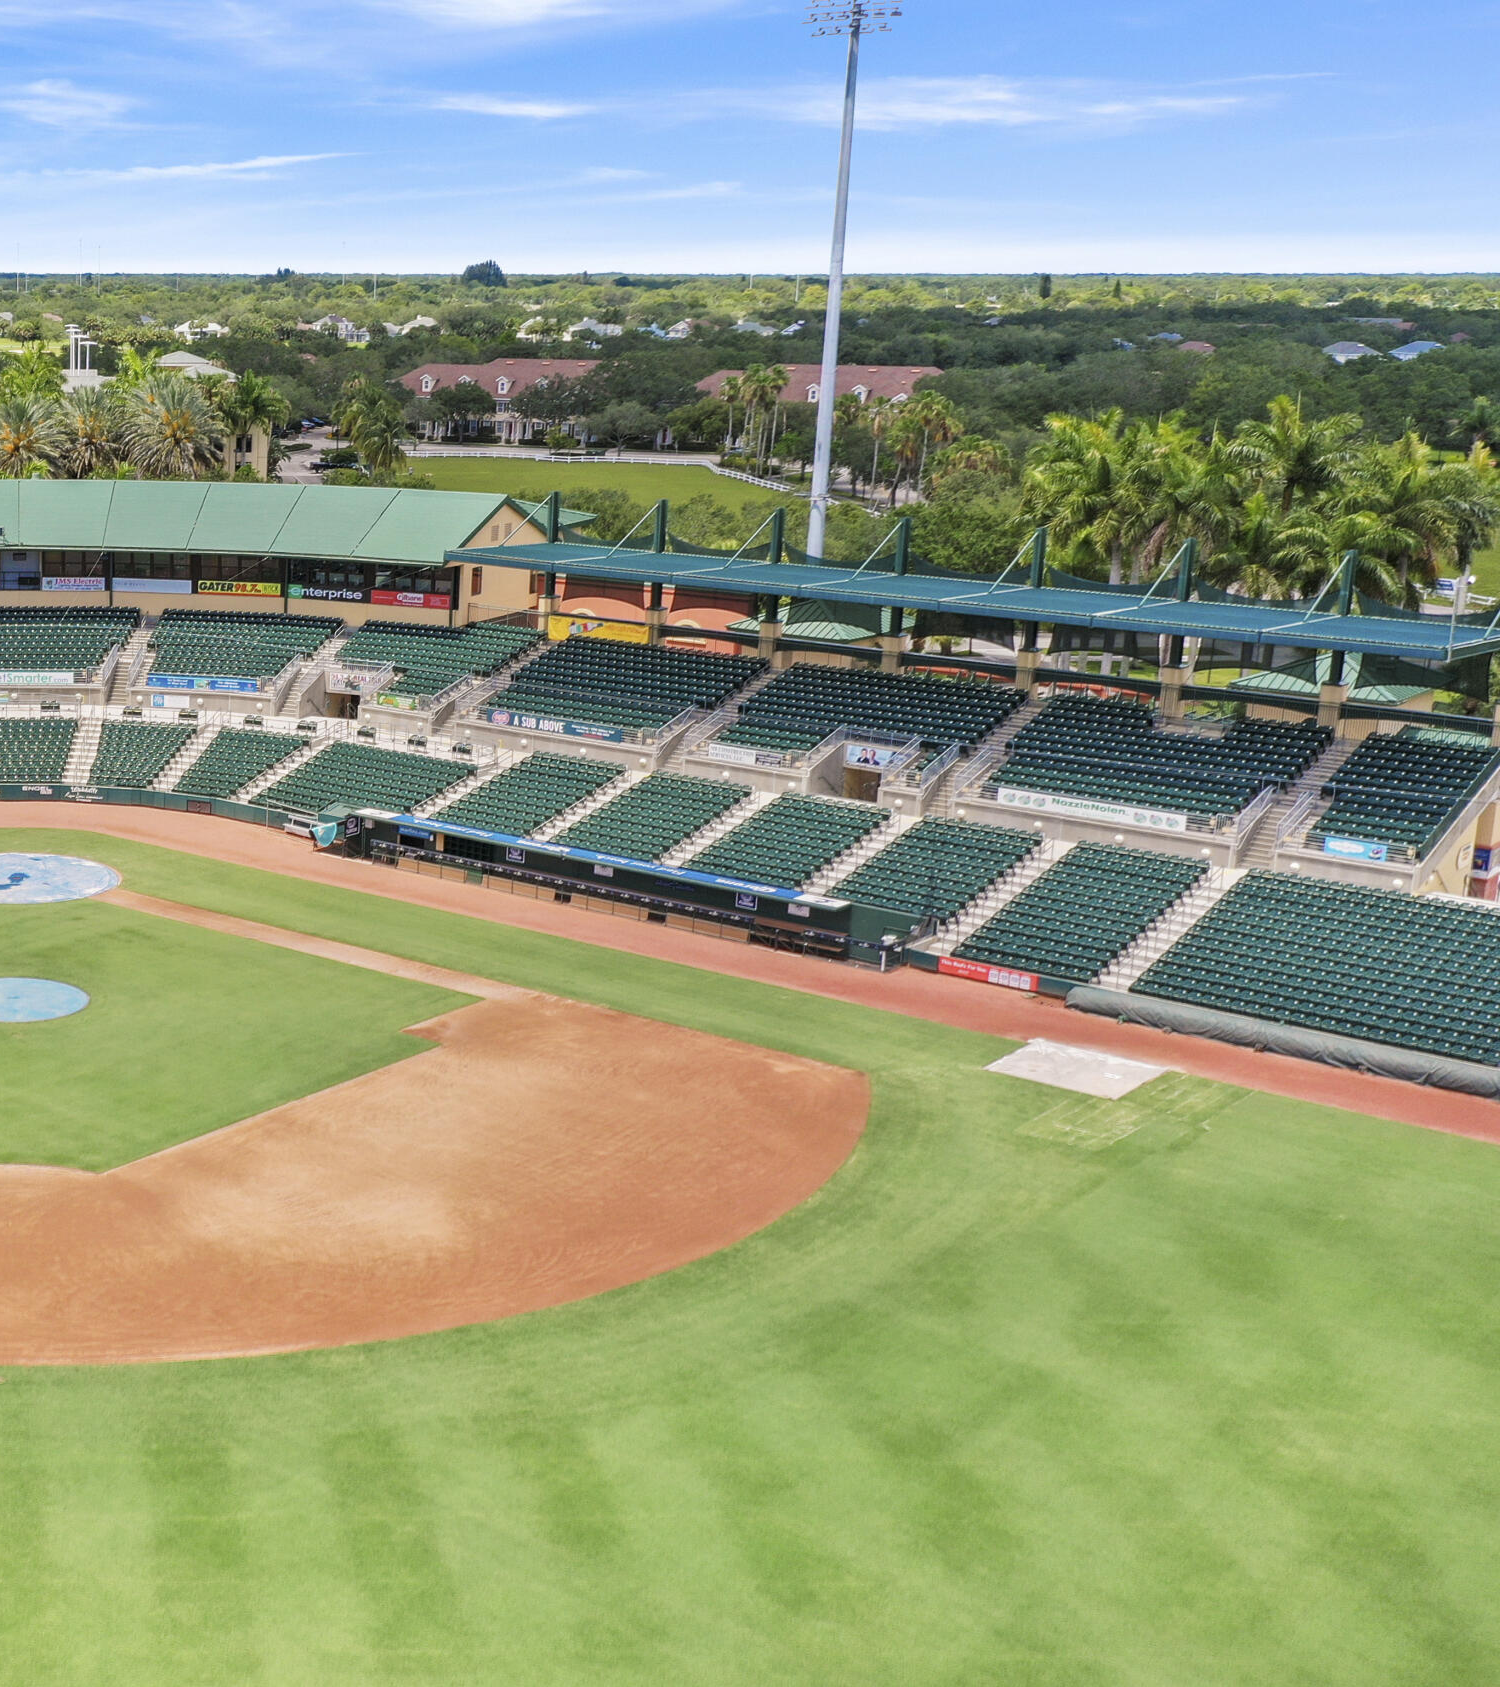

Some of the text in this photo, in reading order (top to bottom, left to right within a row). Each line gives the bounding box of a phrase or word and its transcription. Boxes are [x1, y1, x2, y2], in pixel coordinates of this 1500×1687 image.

[54, 577, 102, 585] JMS Electric
[199, 581, 234, 593] GATER
[289, 586, 363, 600] enterprise
[513, 715, 519, 726] A
[521, 716, 536, 729] SUB
[538, 718, 565, 733] ABOVE
[1051, 797, 1126, 816] NozzleNolen
